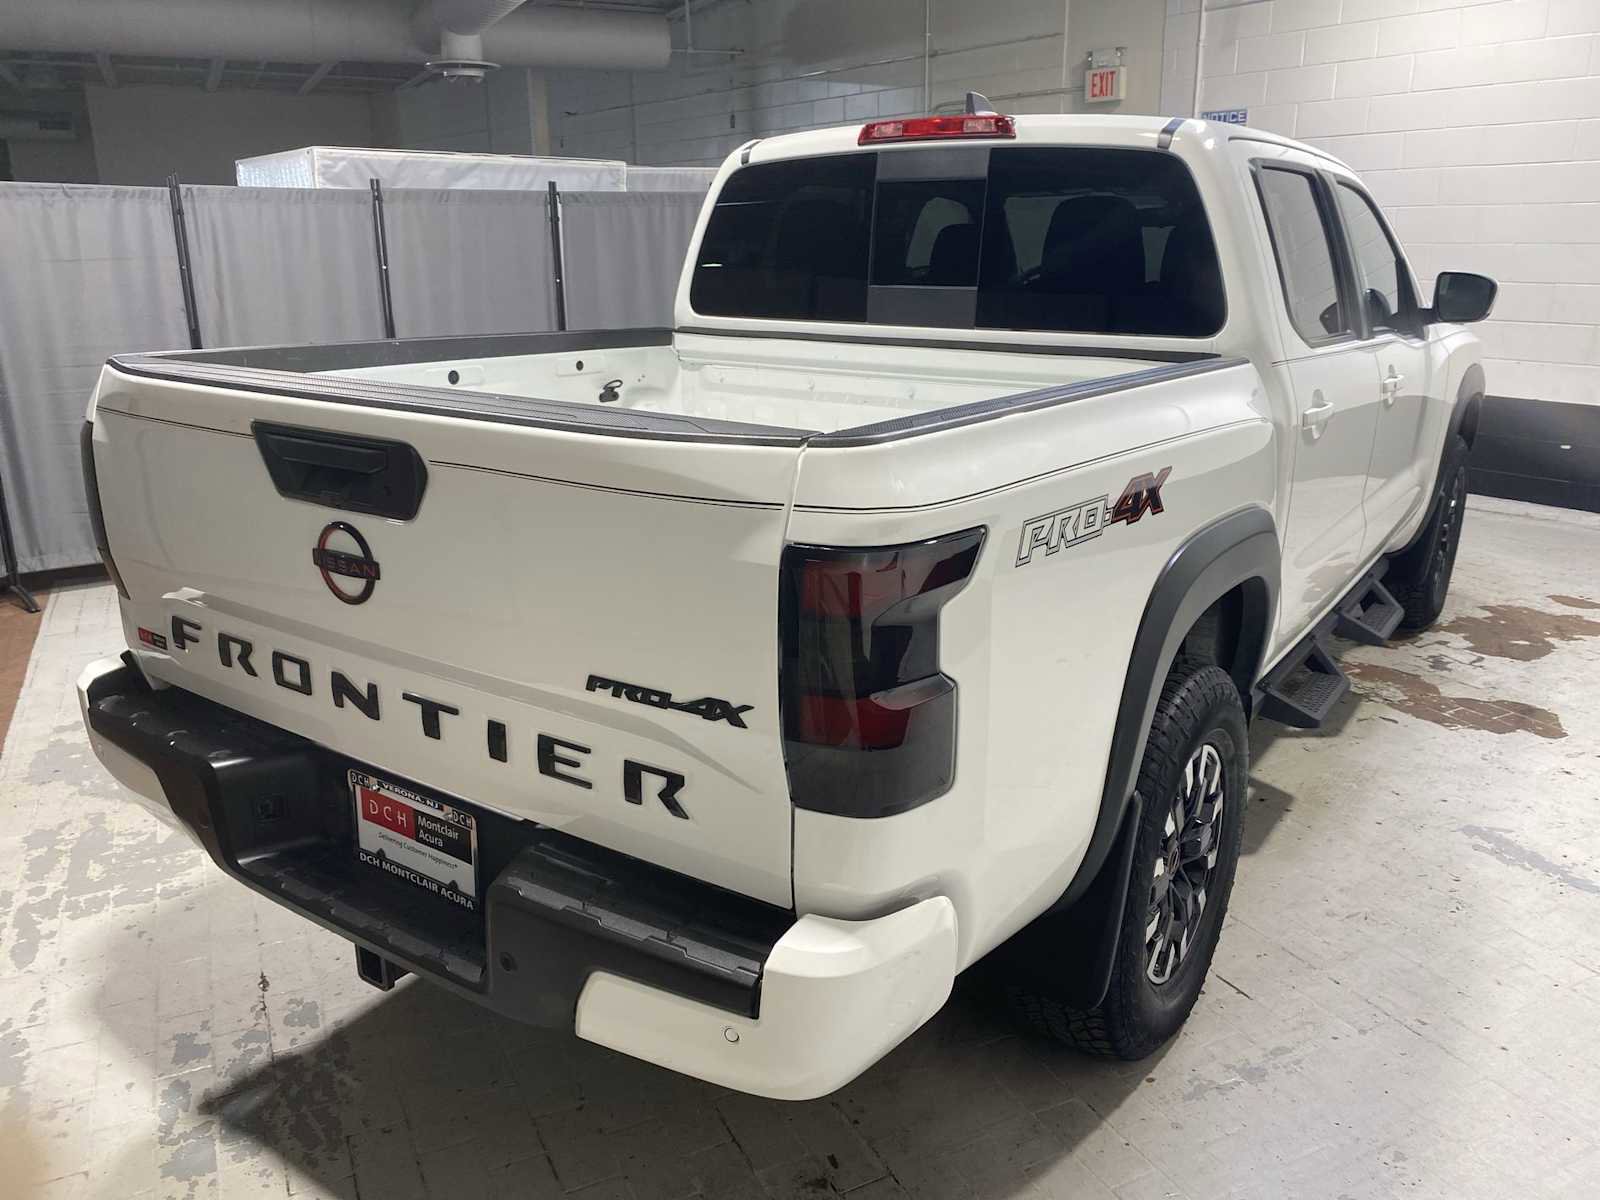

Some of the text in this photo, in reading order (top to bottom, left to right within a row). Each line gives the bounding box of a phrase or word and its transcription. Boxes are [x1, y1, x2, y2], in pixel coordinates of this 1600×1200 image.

[1091, 71, 1116, 97] EXIT
[1202, 111, 1246, 123] NOTICE
[1015, 466, 1173, 568] PRO-4X
[585, 674, 755, 729] PRO-4X
[171, 615, 690, 820] FRONTIER
[351, 772, 369, 785] DCH
[369, 799, 407, 828] DCH
[426, 798, 439, 809] NJ
[417, 815, 459, 840] Montclair
[453, 812, 472, 827] DCH
[418, 830, 443, 847] Acura
[360, 852, 474, 910] DCH MONTCLAIR ACURA
